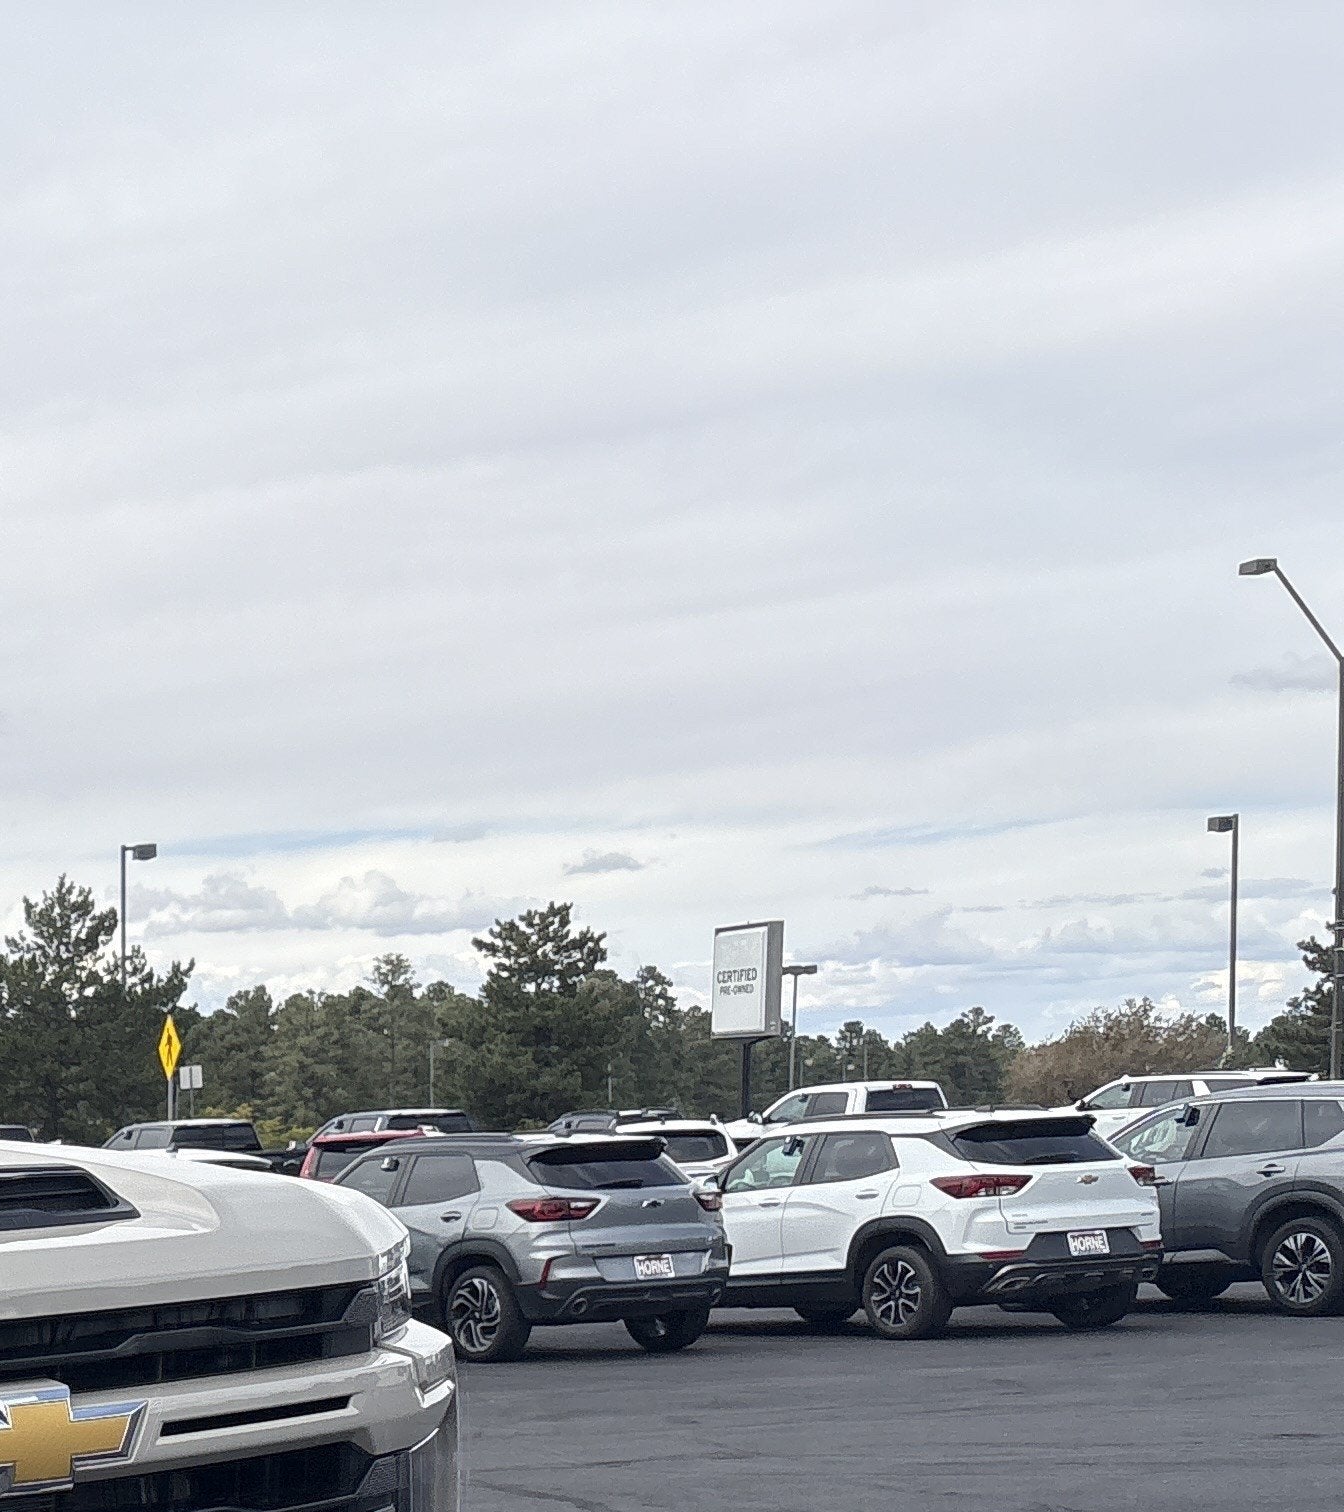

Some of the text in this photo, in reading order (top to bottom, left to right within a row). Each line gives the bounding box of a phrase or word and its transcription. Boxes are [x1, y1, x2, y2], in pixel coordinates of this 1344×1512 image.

[716, 967, 758, 984] CERTIFIED
[719, 983, 755, 996] PRE-OWNED
[1071, 1234, 1106, 1252] HORNE
[636, 1259, 671, 1276] HORNE
